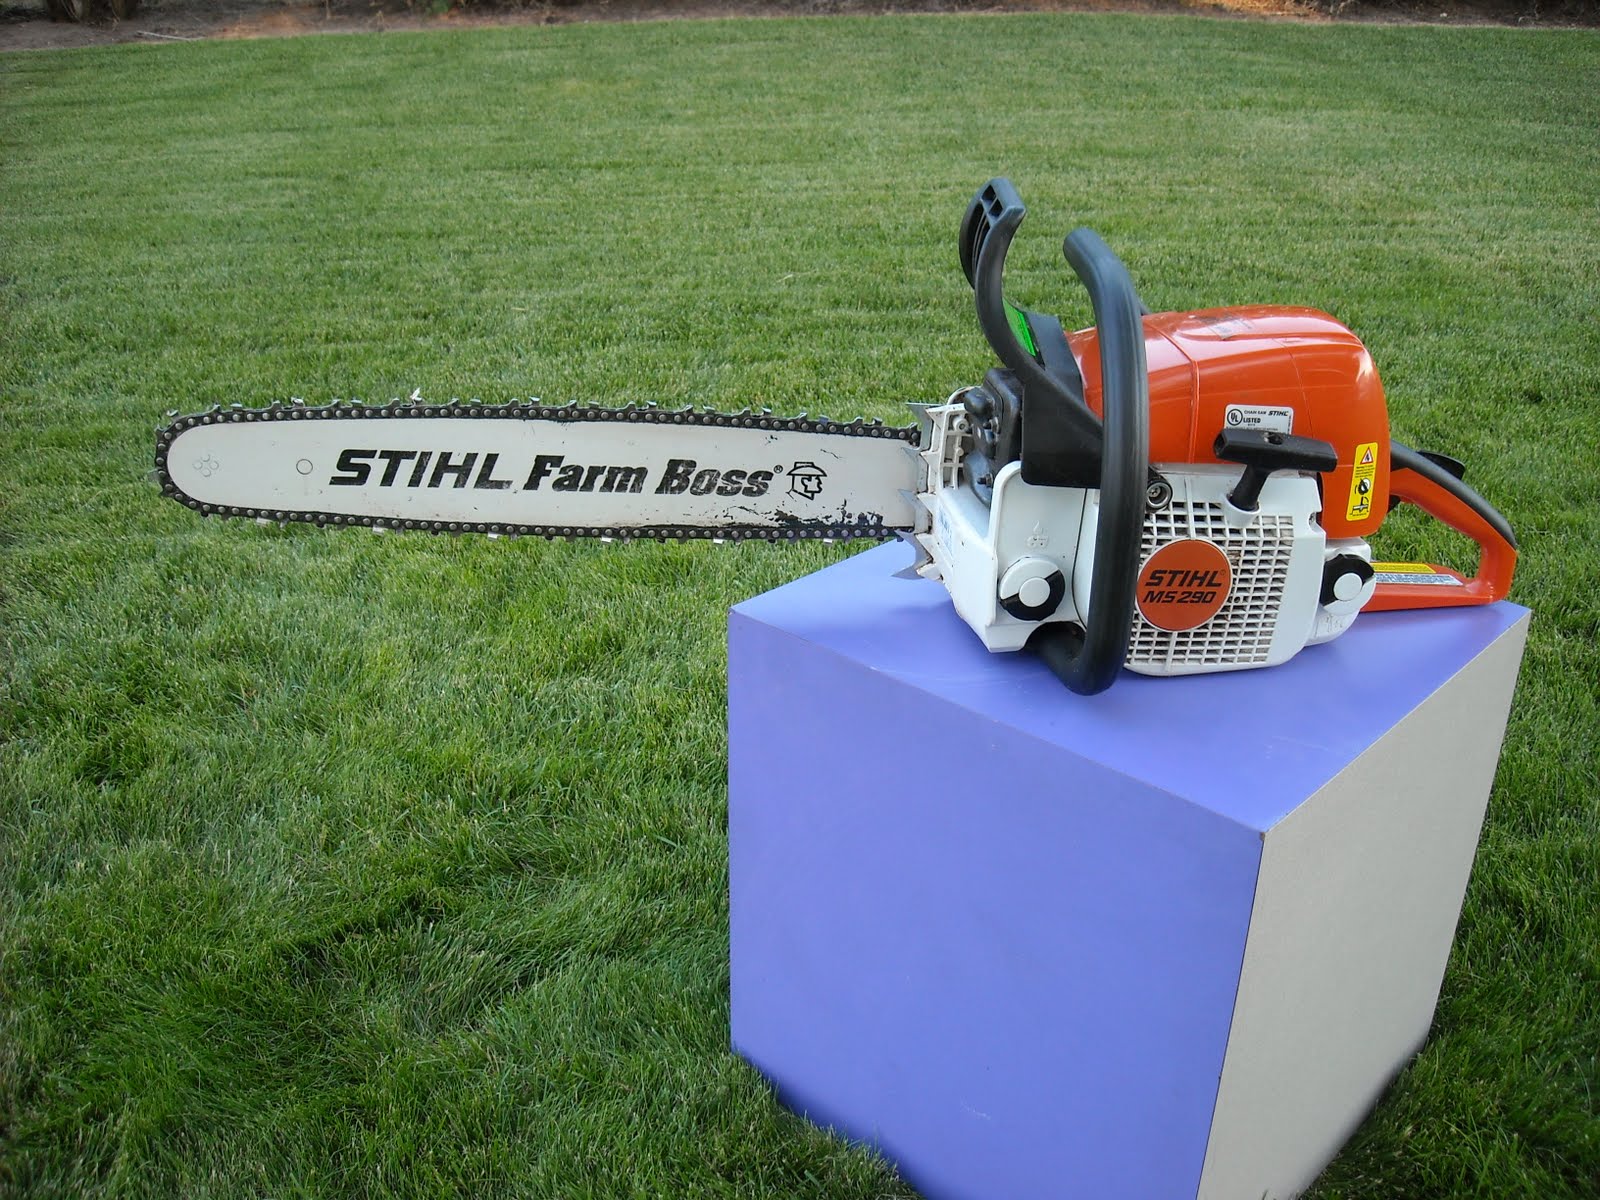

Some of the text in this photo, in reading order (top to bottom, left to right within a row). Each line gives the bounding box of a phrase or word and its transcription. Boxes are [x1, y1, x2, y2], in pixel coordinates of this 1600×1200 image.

[329, 449, 513, 490] STIHL
[523, 455, 649, 493] Farm
[1145, 569, 1222, 588] STIHL
[1143, 590, 1217, 604] MS 290
